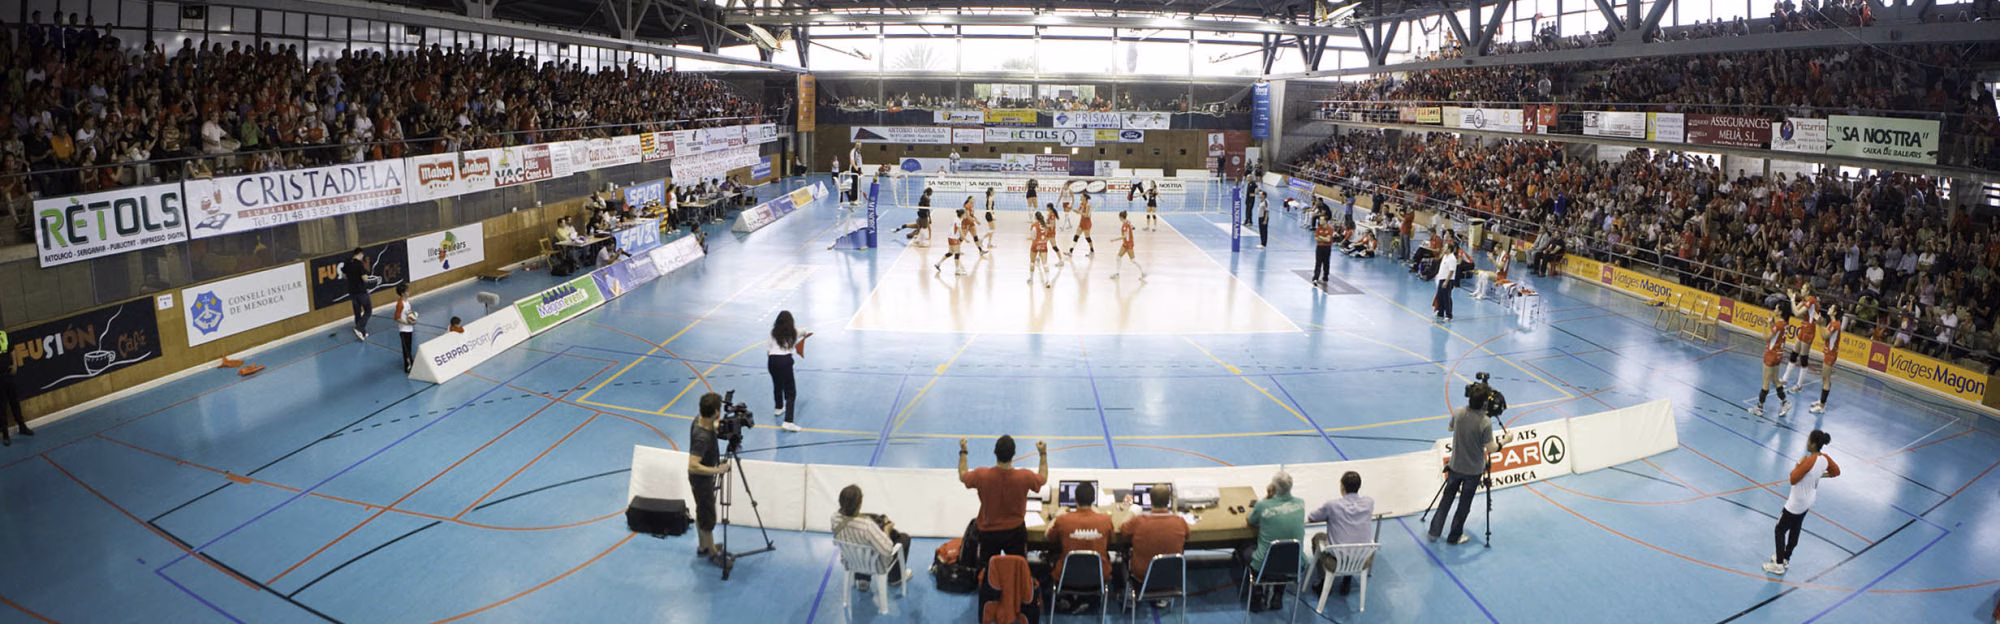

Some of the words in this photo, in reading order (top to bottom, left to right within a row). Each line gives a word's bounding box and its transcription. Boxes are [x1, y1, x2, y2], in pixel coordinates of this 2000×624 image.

[1075, 113, 1119, 123] PRISMA
[1710, 116, 1770, 129] ASSEGURANCES
[1121, 131, 1141, 139] Ford
[1836, 126, 1860, 142] "SA
[1863, 128, 1929, 148] NOSTRA"
[1862, 147, 1881, 155] CAIXA
[1893, 150, 1922, 158] BALEARS
[421, 166, 453, 181] Mahou
[495, 167, 524, 185] VAC
[236, 163, 401, 207] CRISTADELA
[39, 192, 182, 250] RÈTOLS
[271, 214, 289, 225] 971
[291, 211, 304, 221] 48
[228, 290, 266, 306] CONSELL
[267, 281, 302, 297] INSULAR
[1613, 271, 1639, 288] Viatges
[1640, 279, 1672, 296] Magon
[230, 305, 241, 315] DE
[243, 295, 285, 313] MENORCA
[14, 323, 96, 367] FUSIÓN
[1891, 352, 1933, 379] Viatges
[1933, 364, 1985, 395] Magon
